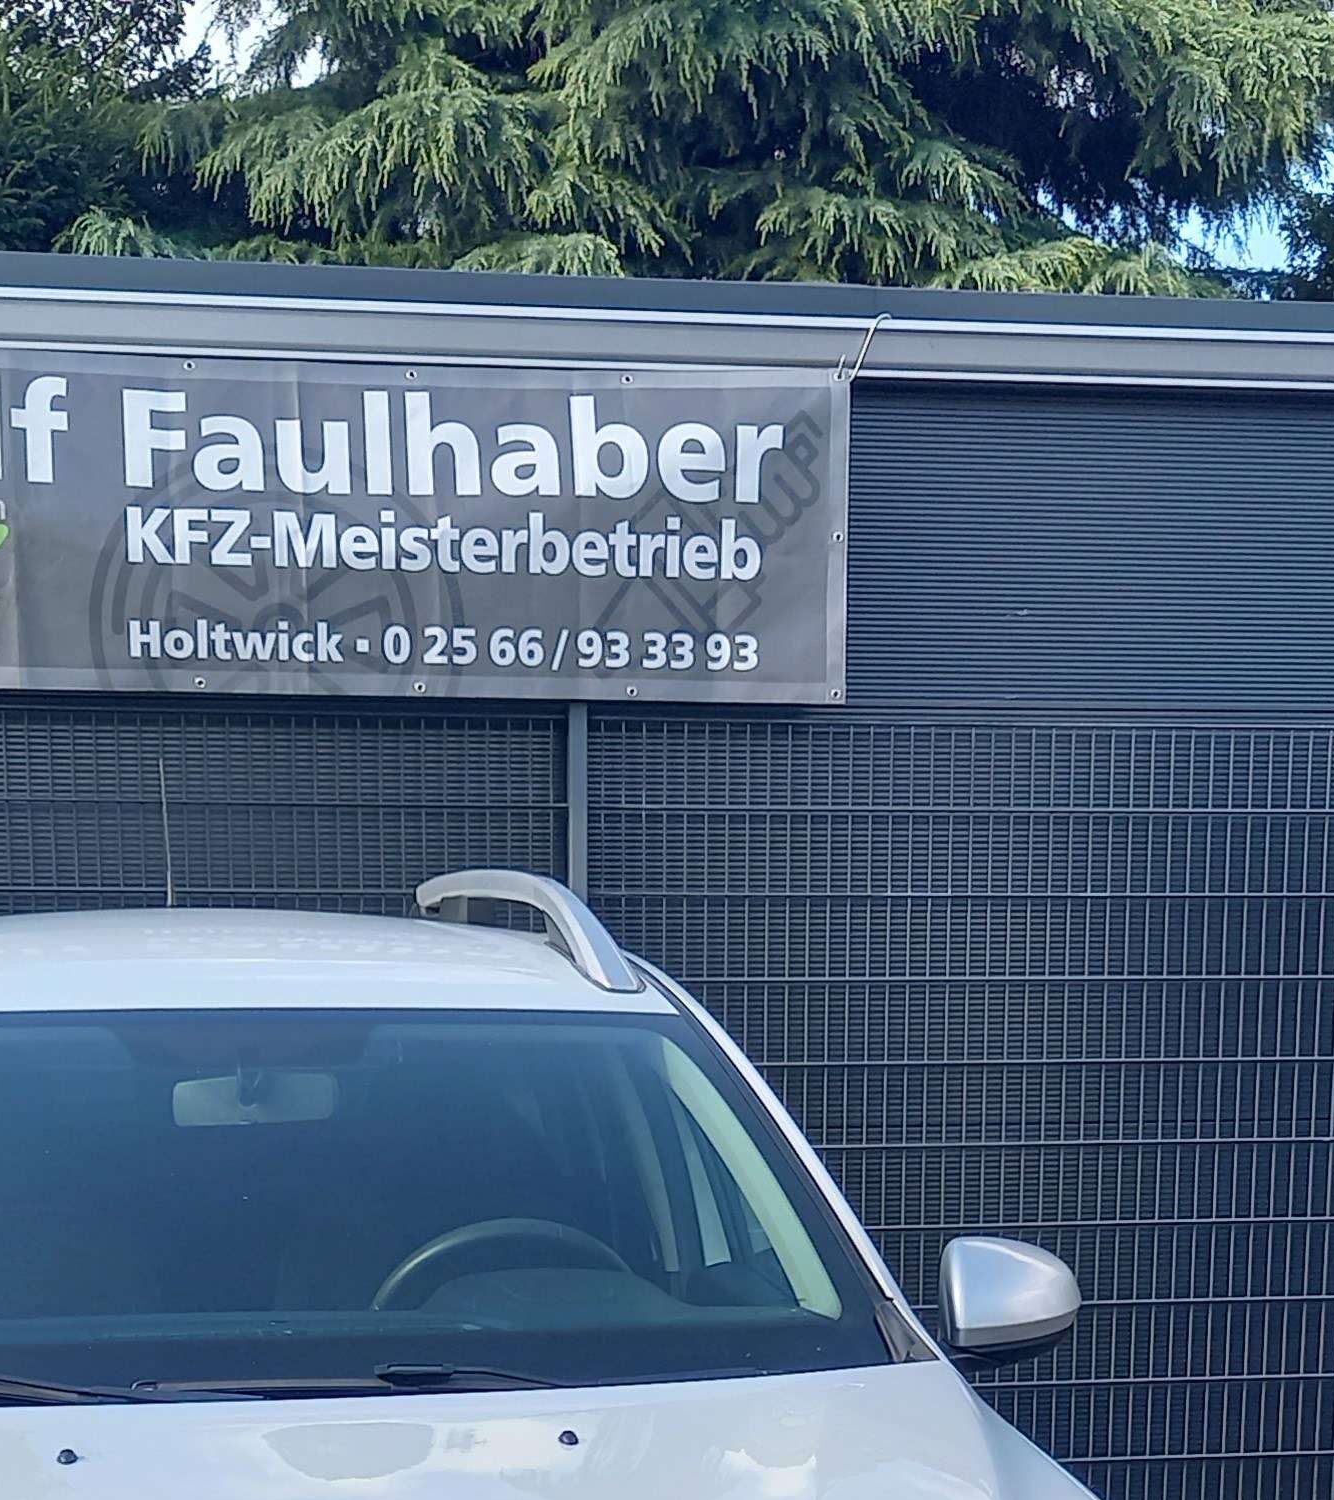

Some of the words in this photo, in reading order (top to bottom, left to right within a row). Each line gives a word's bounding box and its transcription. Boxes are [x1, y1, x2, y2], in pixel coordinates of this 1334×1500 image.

[122, 388, 785, 505] Faulhaber
[125, 505, 761, 581] KFZ-Meisterbetrieb
[128, 618, 344, 663] Holtwick
[383, 624, 411, 666] 0
[422, 624, 478, 667] 25
[641, 633, 695, 671] 33
[706, 633, 760, 672] 93
